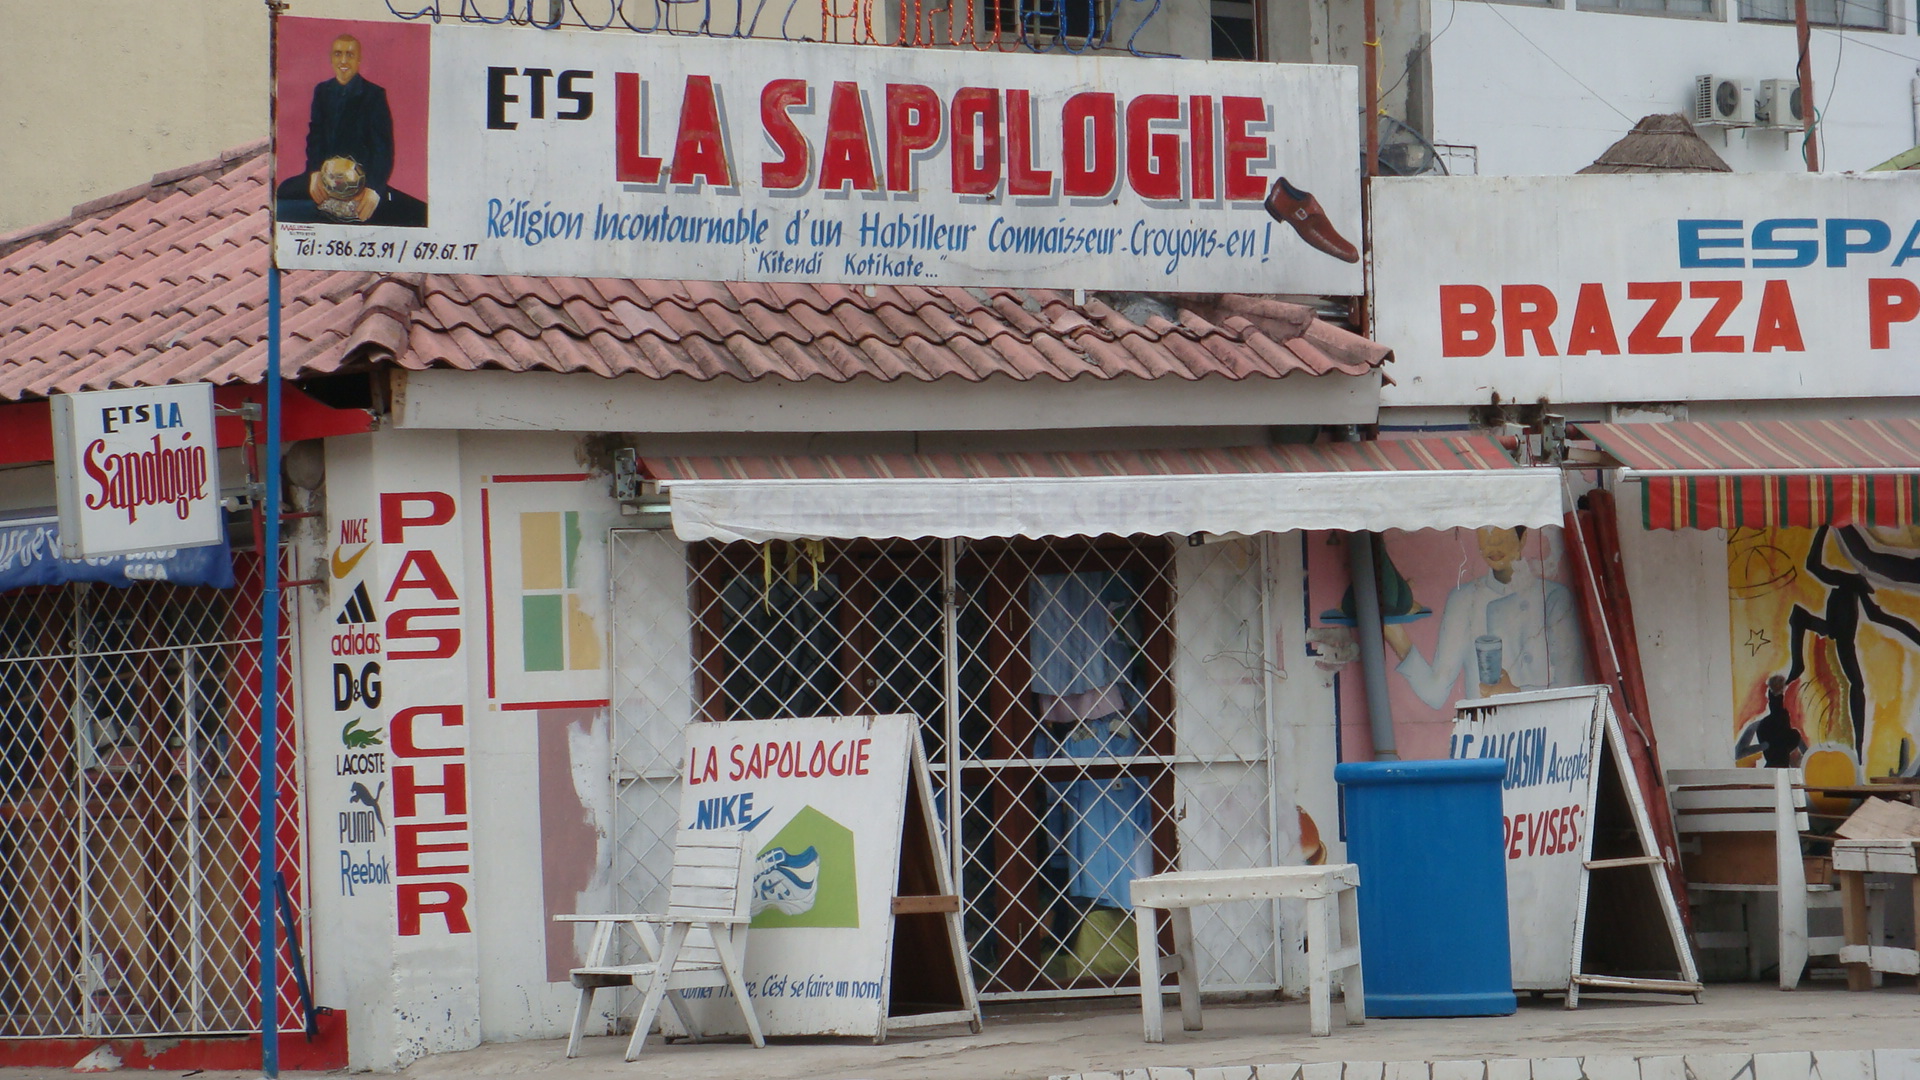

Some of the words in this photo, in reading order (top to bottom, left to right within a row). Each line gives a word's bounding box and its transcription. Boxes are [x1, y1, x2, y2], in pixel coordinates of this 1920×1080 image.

[487, 66, 594, 130] ETS
[614, 72, 736, 191] LA
[761, 78, 1272, 203] SAPOLOGIE
[593, 203, 769, 245] Incontournable
[785, 209, 843, 247] d'un
[859, 211, 977, 252] Habilleur
[1439, 279, 1806, 358] BRAZZA
[102, 404, 150, 434] ETS
[154, 402, 184, 429] LA
[84, 431, 208, 525] Sapologie
[340, 518, 369, 545] NIKE
[380, 491, 462, 661] PAS
[331, 623, 382, 657] adidas
[333, 661, 382, 712] D&G
[336, 752, 386, 776] LACOSTE
[689, 745, 719, 785] LA
[729, 738, 872, 782] SAPOLOGIE
[339, 810, 376, 844] PUMA
[390, 704, 472, 937] CHER
[696, 792, 754, 830] NIKE
[340, 850, 391, 896] Reebok
[790, 980, 805, 998] se
[805, 974, 834, 998] faire
[835, 980, 848, 998] un
